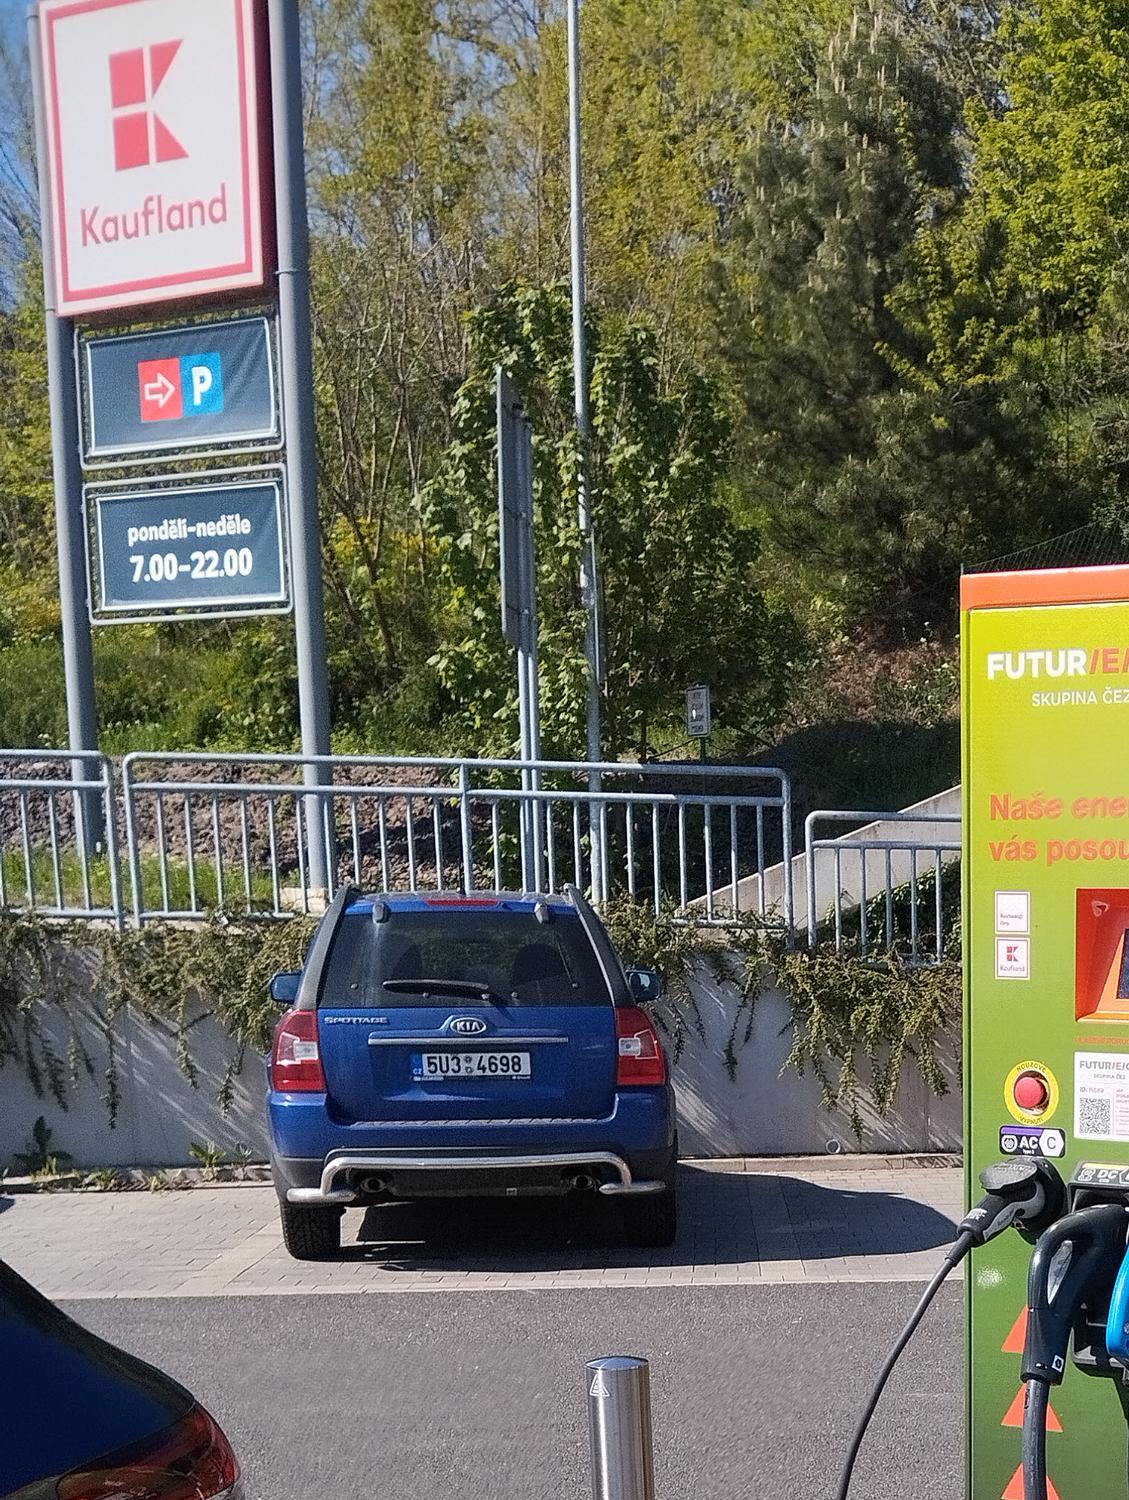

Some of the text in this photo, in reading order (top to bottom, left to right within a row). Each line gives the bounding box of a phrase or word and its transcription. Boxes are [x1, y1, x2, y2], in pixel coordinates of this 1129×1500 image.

[80, 183, 228, 248] Kaufland
[191, 366, 212, 406] P
[127, 515, 251, 546] pondělí-neděle
[129, 553, 253, 583] 7.00-22.00
[1031, 690, 1097, 708] SKUPINA
[989, 793, 1062, 822] Naše
[989, 834, 1037, 862] vás
[456, 1019, 481, 1032] KIA
[427, 1055, 522, 1075] 5U3 4698
[1020, 1136, 1038, 1149] AC
[1047, 1136, 1056, 1150] C
[1097, 1169, 1118, 1179] DC
